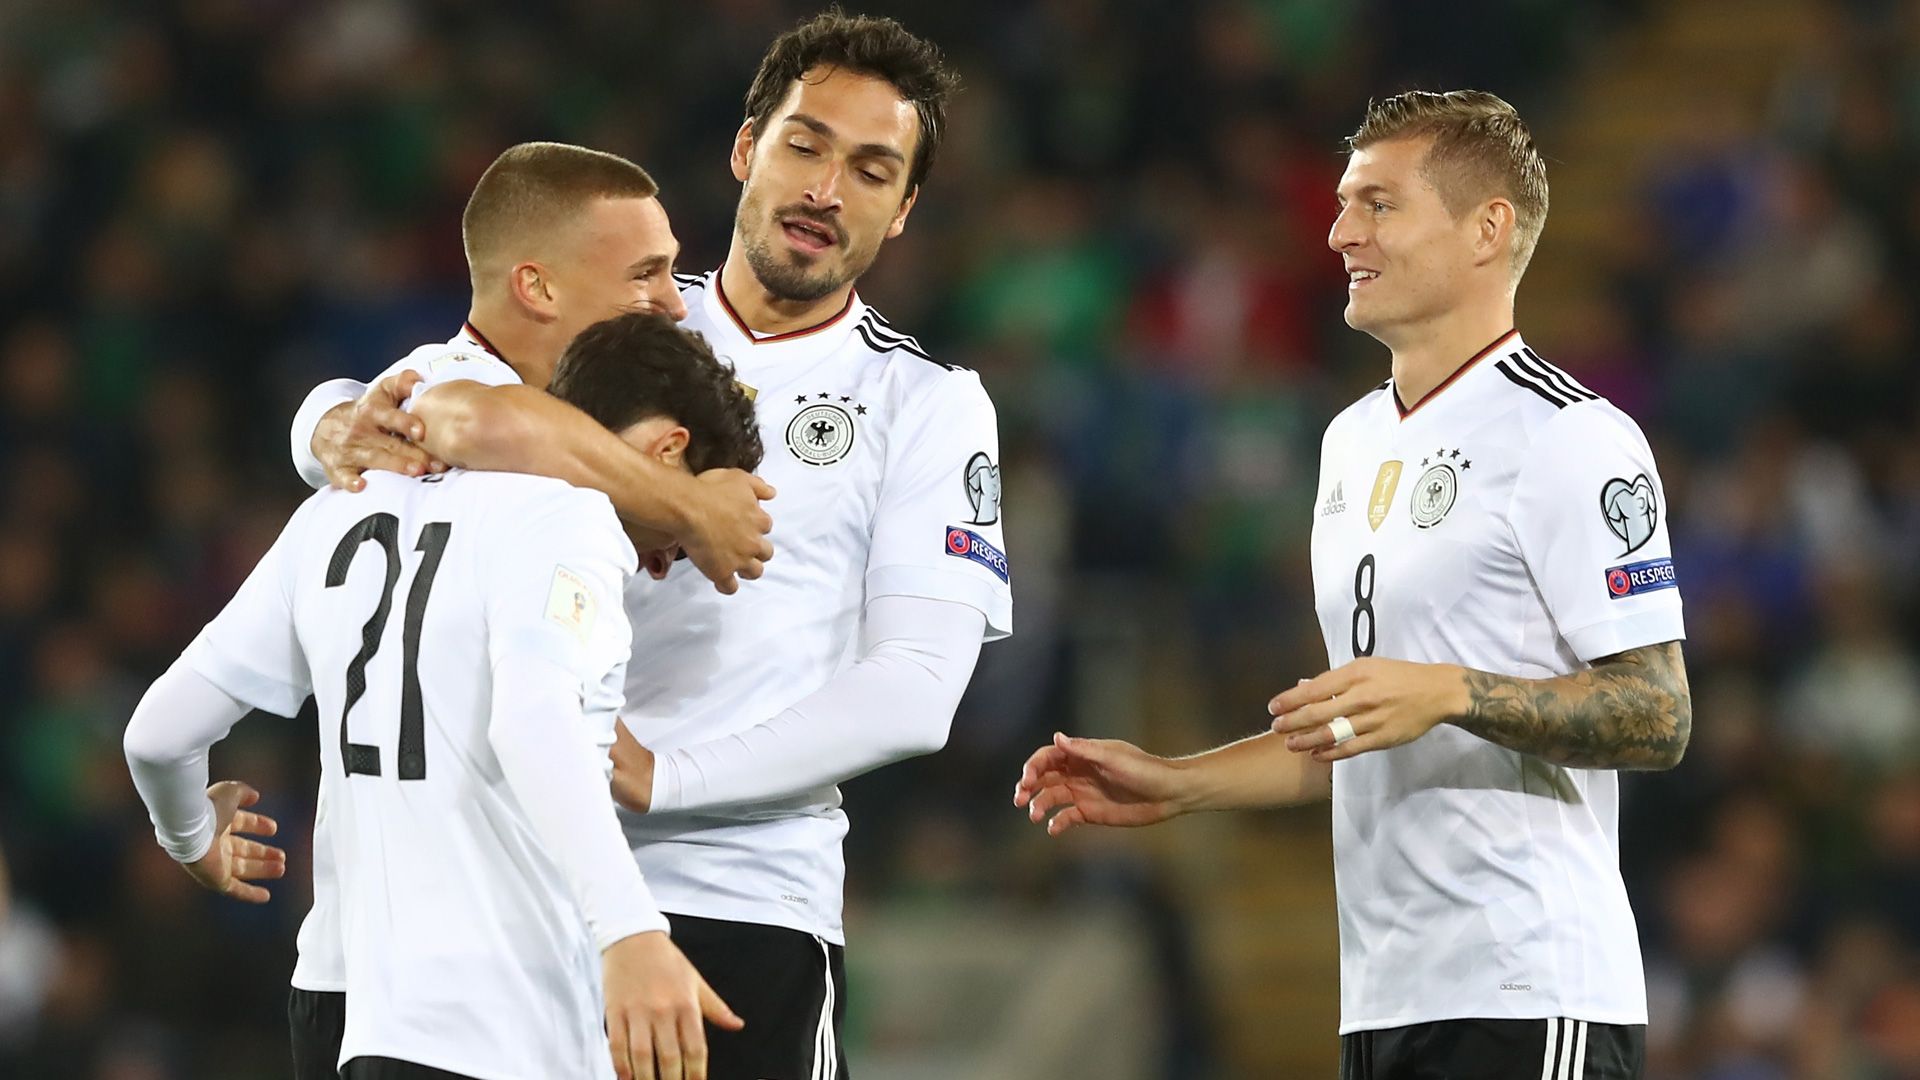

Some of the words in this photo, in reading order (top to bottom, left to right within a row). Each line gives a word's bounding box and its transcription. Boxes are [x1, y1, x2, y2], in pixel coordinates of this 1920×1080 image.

[971, 539, 1008, 575] RESPECT
[1630, 565, 1675, 586] RESPECT
[1352, 553, 1375, 659] 8
[325, 512, 452, 780] 21
